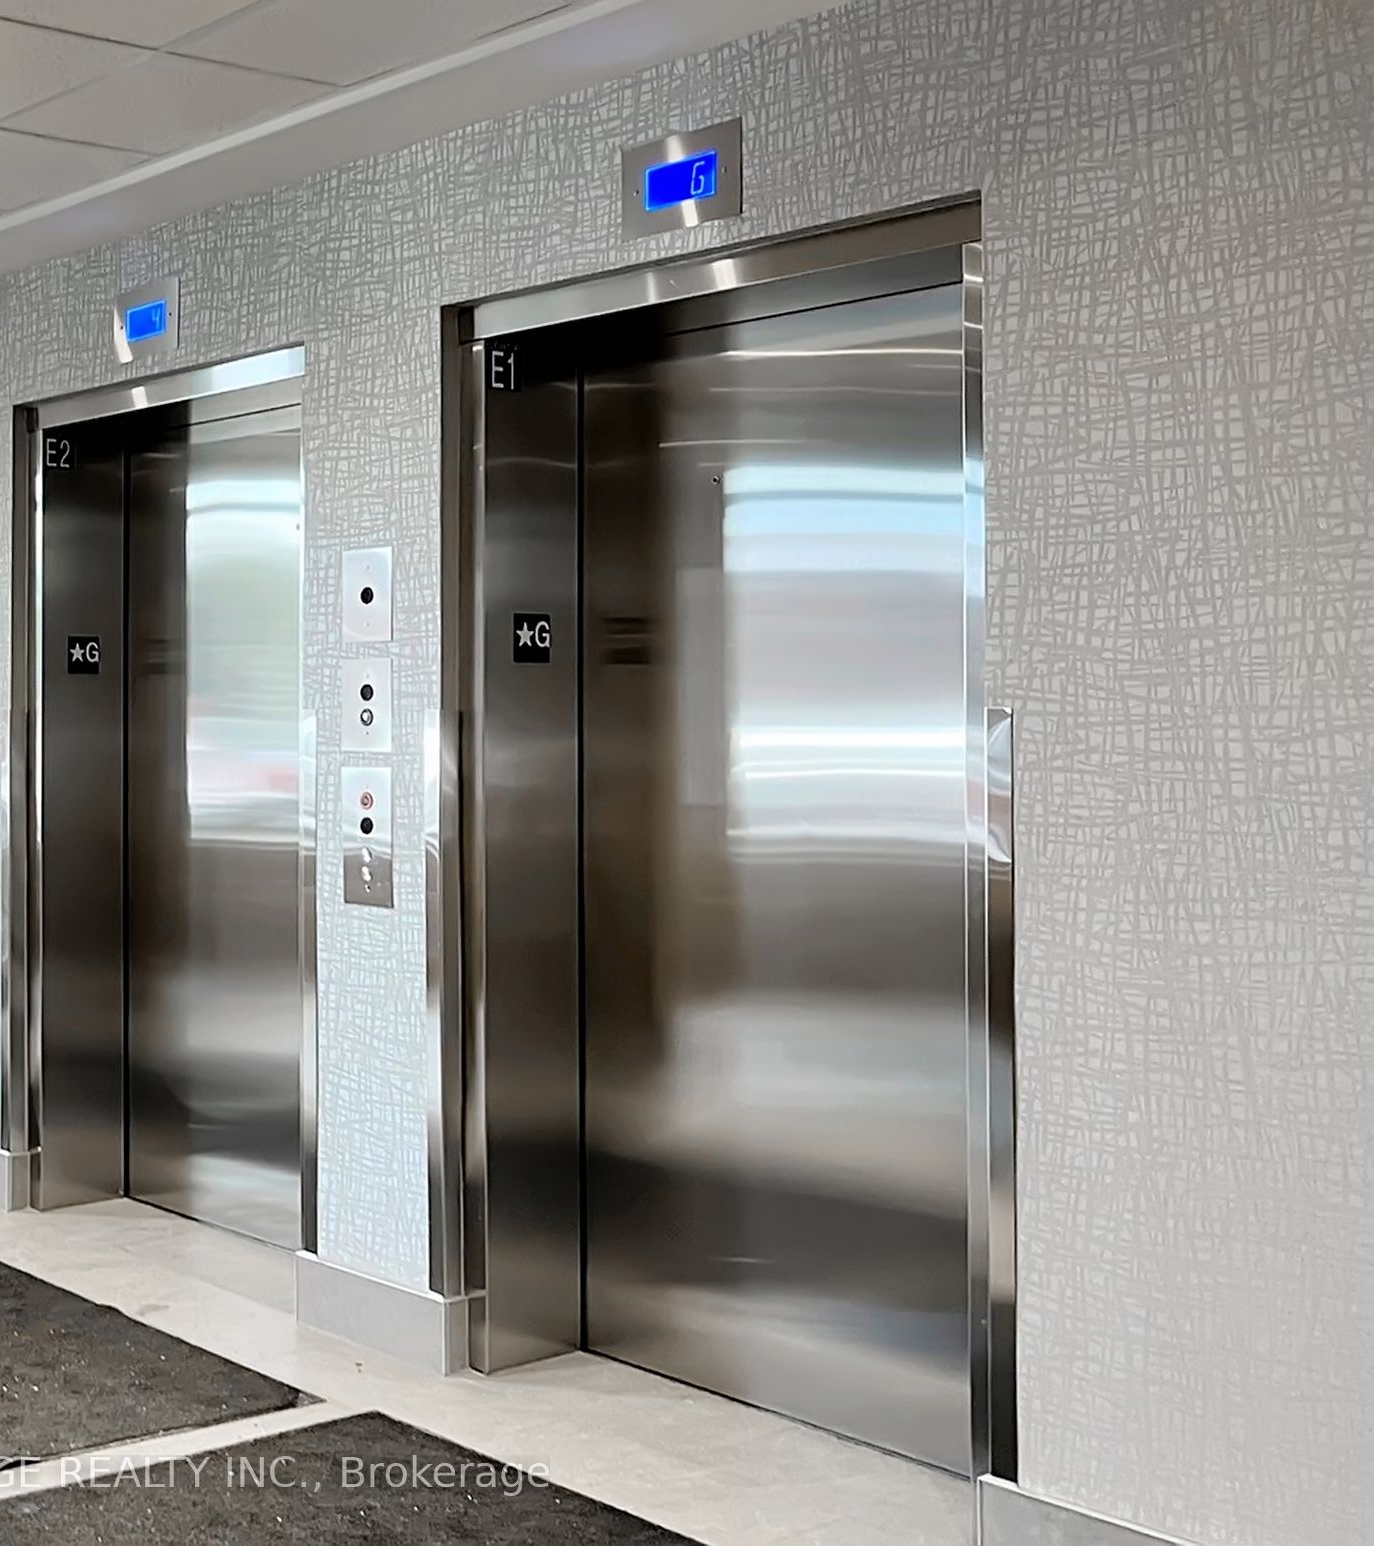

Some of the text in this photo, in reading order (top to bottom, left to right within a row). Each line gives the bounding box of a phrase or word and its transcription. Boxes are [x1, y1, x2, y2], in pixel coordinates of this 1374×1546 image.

[690, 160, 706, 196] G
[491, 350, 515, 390] E1
[46, 437, 70, 468] E2
[535, 620, 550, 648] G
[85, 641, 100, 663] G
